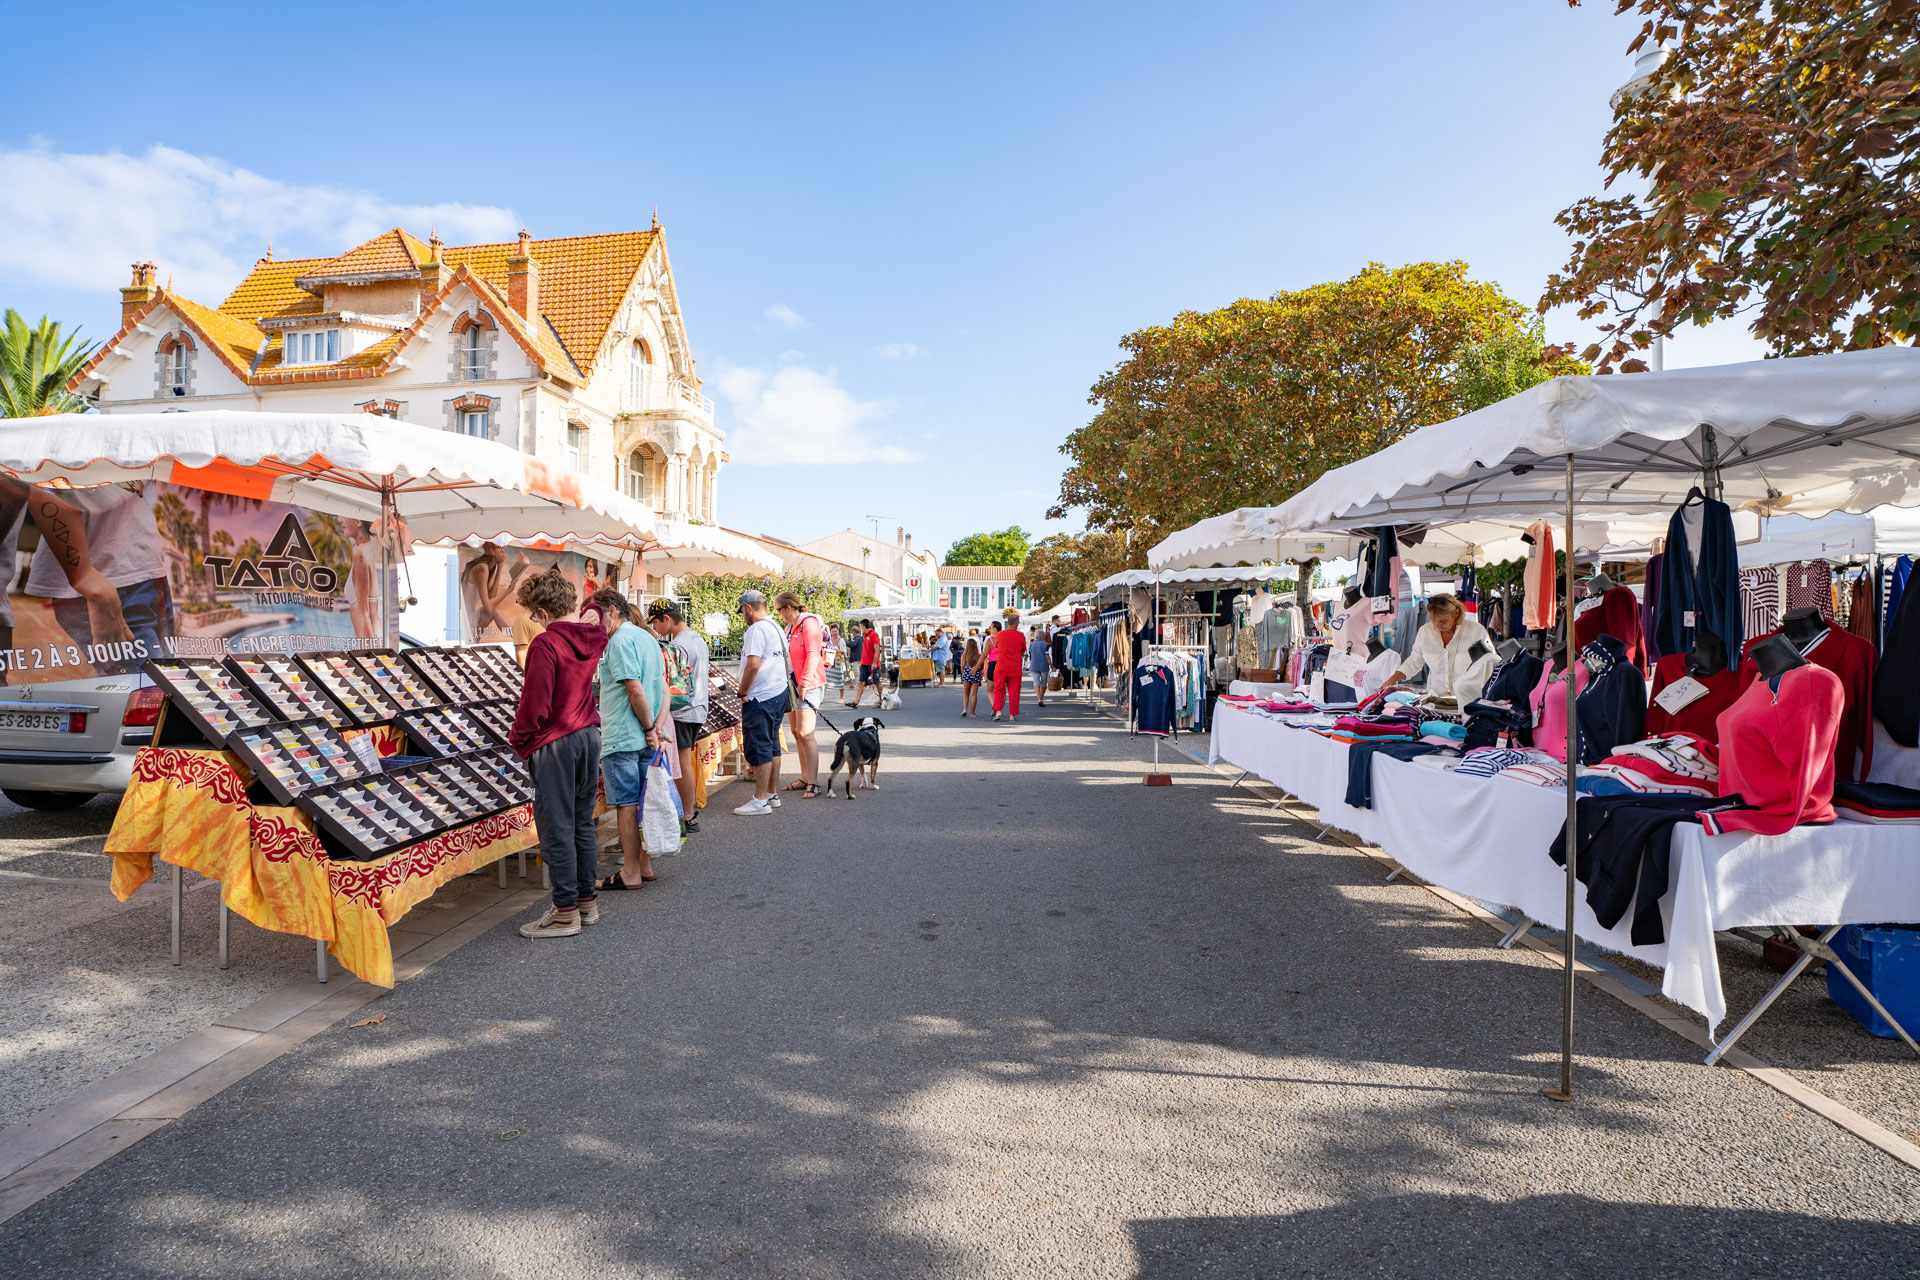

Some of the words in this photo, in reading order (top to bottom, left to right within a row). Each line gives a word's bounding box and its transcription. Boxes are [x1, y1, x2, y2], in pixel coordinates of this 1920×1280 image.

[203, 556, 337, 593] TATOO
[910, 579, 918, 587] U
[255, 592, 302, 605] TATOUAGE
[301, 594, 335, 609] EMPORAIRE
[32, 648, 46, 669] 2
[50, 644, 64, 668] À
[66, 646, 81, 666] 3
[87, 639, 149, 664] JOURS
[164, 636, 229, 655] WATERPROOF
[241, 634, 287, 653] ENCRE
[289, 632, 334, 651] COSÉTIQUE
[0, 714, 61, 729] ES-283-ES
